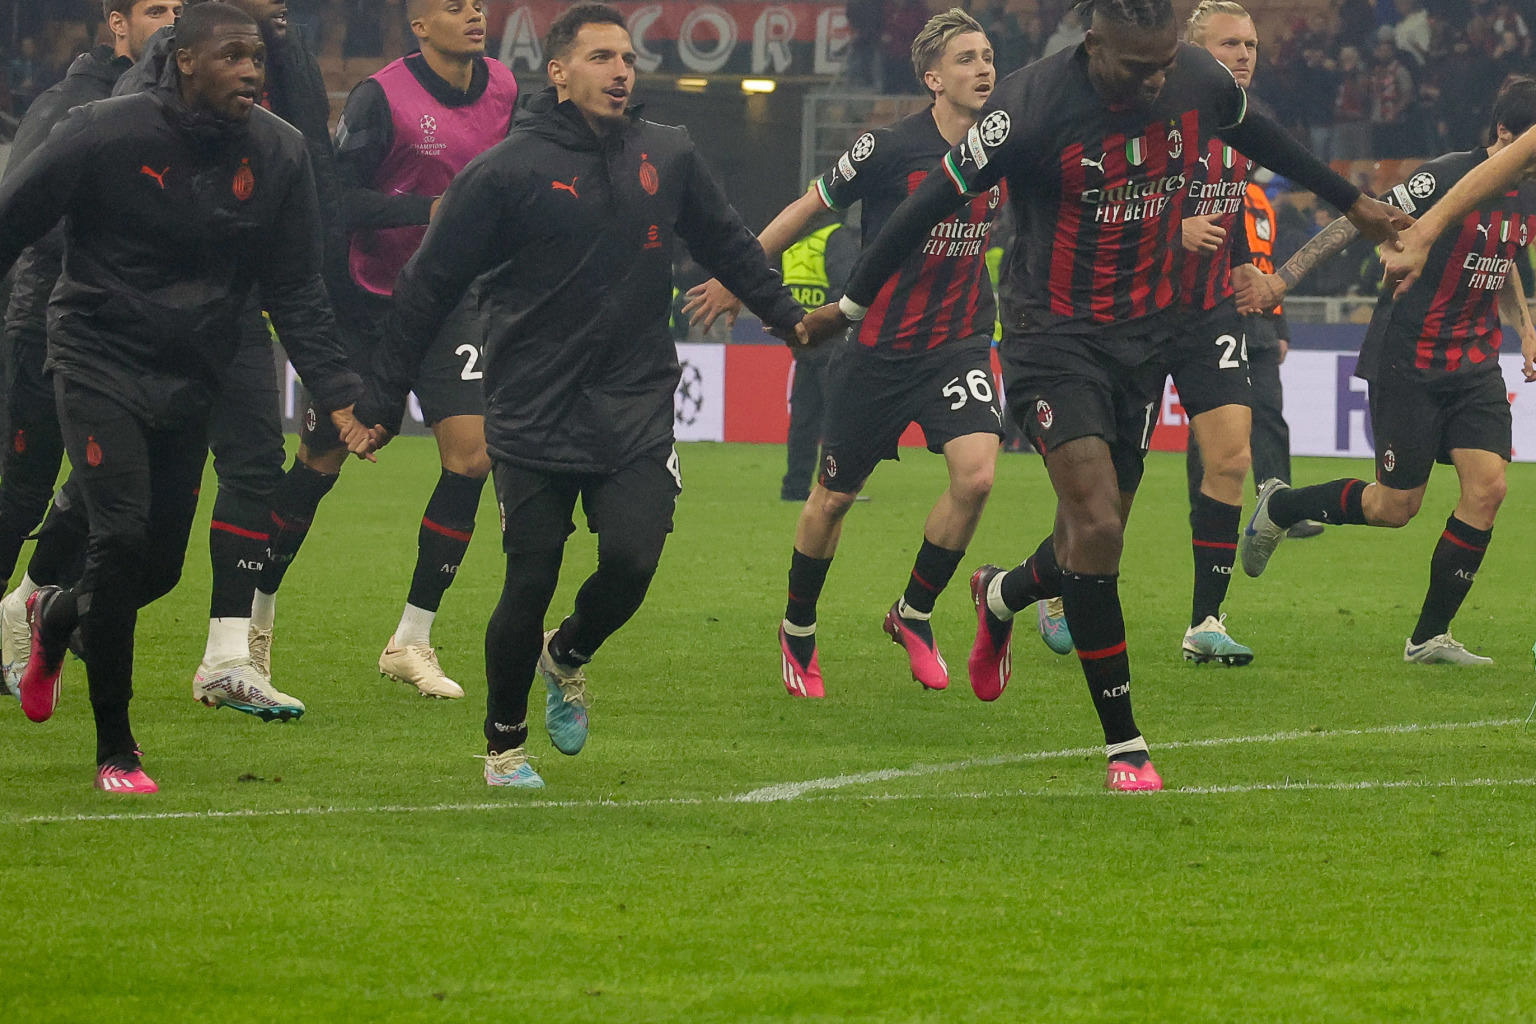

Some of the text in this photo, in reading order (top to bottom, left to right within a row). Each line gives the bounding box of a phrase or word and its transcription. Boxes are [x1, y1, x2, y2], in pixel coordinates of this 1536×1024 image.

[1094, 202, 1120, 223] FLY
[922, 239, 982, 257] FLY BETTER
[1467, 273, 1487, 289] FLY
[942, 369, 993, 411] 56
[1102, 680, 1131, 699] ACM
